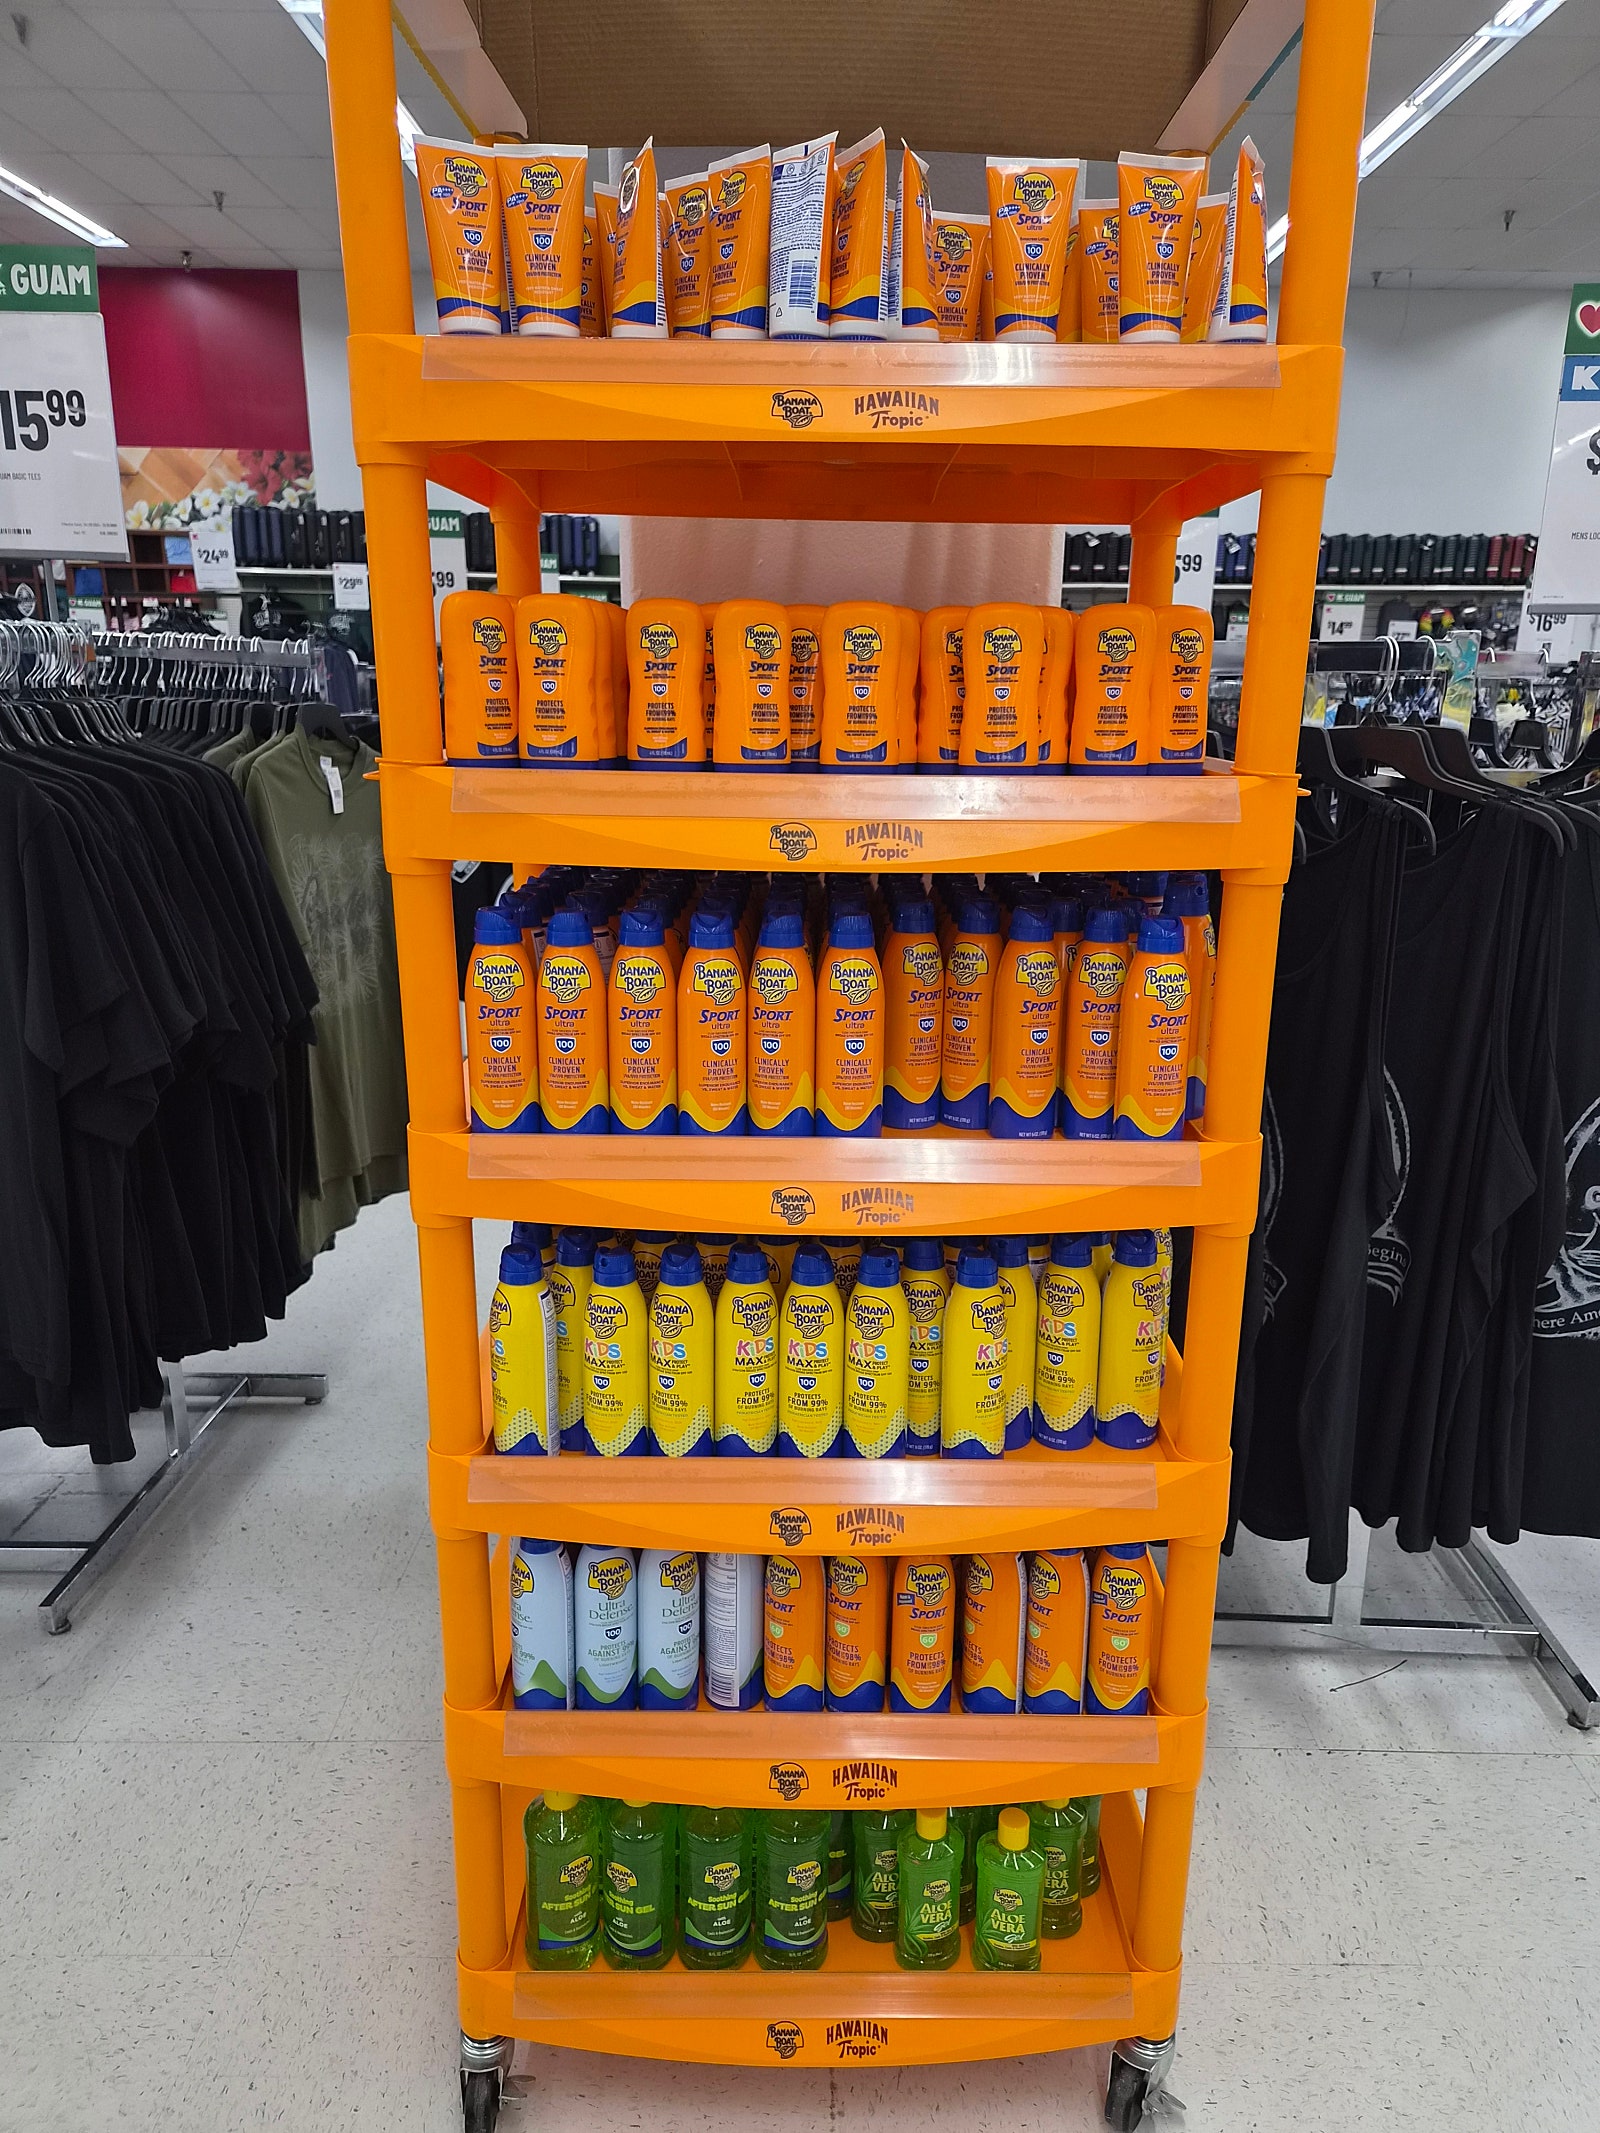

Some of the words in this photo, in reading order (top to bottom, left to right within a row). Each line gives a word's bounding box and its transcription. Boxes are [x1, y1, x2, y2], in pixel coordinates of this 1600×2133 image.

[524, 168, 559, 179] BANANA
[531, 178, 553, 190] BOAT
[1016, 176, 1052, 190] BANANA
[1145, 178, 1178, 192] BANANA
[1023, 188, 1046, 199] BOAT
[1152, 189, 1175, 200] BOAT
[525, 202, 561, 214] SPORT
[1016, 214, 1052, 225] SPORT
[1148, 211, 1183, 224] SPORT
[535, 235, 551, 245] 100
[1027, 245, 1042, 254] 100
[1158, 244, 1173, 254] 100
[524, 254, 560, 263] CLINICALLY
[530, 262, 556, 271] PROVEN
[1015, 262, 1050, 272] CLINICALLY
[1146, 262, 1180, 272] CLINICALLY
[10, 263, 91, 296] GUAM
[1020, 271, 1046, 280] PROVEN
[1152, 271, 1176, 280] PROVEN
[773, 394, 817, 407] BANANA
[854, 391, 939, 416] HAWAIIAN
[783, 406, 812, 419] BOAT
[868, 411, 923, 429] Tropic
[1571, 532, 1588, 540] MENS
[532, 626, 563, 635] BANANA
[642, 630, 674, 640] BANANA
[538, 634, 558, 644] BOAT
[1101, 632, 1133, 642] BANANA
[648, 638, 669, 649] BOAT
[1106, 642, 1128, 652] BOAT
[534, 658, 566, 669] SPORT
[644, 661, 676, 672] SPORT
[1100, 665, 1133, 676] SPORT
[543, 682, 555, 690] 100
[654, 684, 666, 693] 100
[1108, 688, 1120, 696] 100
[771, 827, 812, 840] BANANA
[845, 823, 923, 848] HAWAIIAN
[780, 838, 807, 850] BOAT
[858, 843, 909, 861] Tropic
[475, 960, 519, 975] BANANA
[619, 961, 661, 977] BANANA
[1147, 968, 1189, 983] BANANA
[484, 974, 514, 990] BOAT
[624, 976, 656, 991] BOAT
[1159, 983, 1186, 998] BOAT
[478, 1006, 522, 1020] SPORT
[619, 1007, 663, 1021] SPORT
[1148, 1014, 1189, 1028] SPORT
[492, 1039, 509, 1047] 100
[633, 1040, 649, 1048] 100
[1161, 1047, 1177, 1055] 100
[483, 1056, 521, 1064] CLINICALLY
[623, 1057, 660, 1066] CLINICALLY
[1149, 1064, 1183, 1073] CLINICALLY
[1154, 1073, 1180, 1081] PROVEN
[772, 1190, 811, 1204] BANANA
[841, 1187, 914, 1212] HAWAIIAN
[781, 1203, 806, 1215] BOAT
[853, 1207, 900, 1225] Tropic
[587, 1298, 623, 1314] BANANA
[788, 1297, 829, 1313] BANANA
[589, 1312, 615, 1325] BOAT
[794, 1313, 824, 1326] BOAT
[1570, 1310, 1600, 1324] Am
[585, 1355, 605, 1368] MAX
[787, 1356, 813, 1368] MAX
[594, 1377, 609, 1386] 100
[800, 1378, 815, 1387] 100
[591, 1390, 615, 1399] PROTECTS
[586, 1397, 603, 1406] FROM
[788, 1396, 808, 1406] FROM
[771, 1512, 807, 1525] BANANA
[836, 1508, 905, 1533] HAWAIIAN
[779, 1524, 803, 1535] BOAT
[847, 1528, 892, 1546] Tropic
[590, 1562, 629, 1579] BANANA
[909, 1568, 946, 1582] BANANA
[1105, 1568, 1142, 1586] BANANA
[599, 1576, 625, 1591] BOAT
[916, 1582, 943, 1596] BOAT
[1109, 1585, 1137, 1597] BOAT
[598, 1600, 625, 1612] Ultra
[910, 1607, 947, 1619] SPORT
[1102, 1609, 1142, 1623] SPORT
[607, 1629, 621, 1637] 100
[588, 1648, 621, 1658] AGAINST
[910, 1651, 945, 1659] PROTECTS
[1101, 1651, 1137, 1664] PROTECTS
[907, 1660, 926, 1668] FROM
[931, 1660, 946, 1668] 98%
[1100, 1659, 1118, 1671] FROM
[1123, 1665, 1139, 1673] 98%
[770, 1766, 805, 1779] BANANA
[832, 1763, 898, 1788] HAWAIIAN
[778, 1779, 800, 1789] BOAT
[842, 1782, 885, 1800] Tropic
[706, 1865, 740, 1876] BANANA
[926, 1881, 949, 1892] BANANA
[708, 1893, 737, 1903] Soothing
[996, 1891, 1021, 1901] BANANA
[636, 1905, 655, 1914] GEL
[688, 1897, 715, 1911] AFTER
[920, 1900, 952, 1914] ALOE
[920, 1913, 952, 1924] VERA
[990, 1909, 1025, 1924] ALOE
[713, 1919, 731, 1927] ALOE
[991, 1920, 1025, 1933] VERA
[767, 2025, 800, 2037] BANANA
[826, 2020, 888, 2045] HAWAIIAN
[775, 2037, 796, 2049] BOAT
[836, 2040, 876, 2058] Tropic
